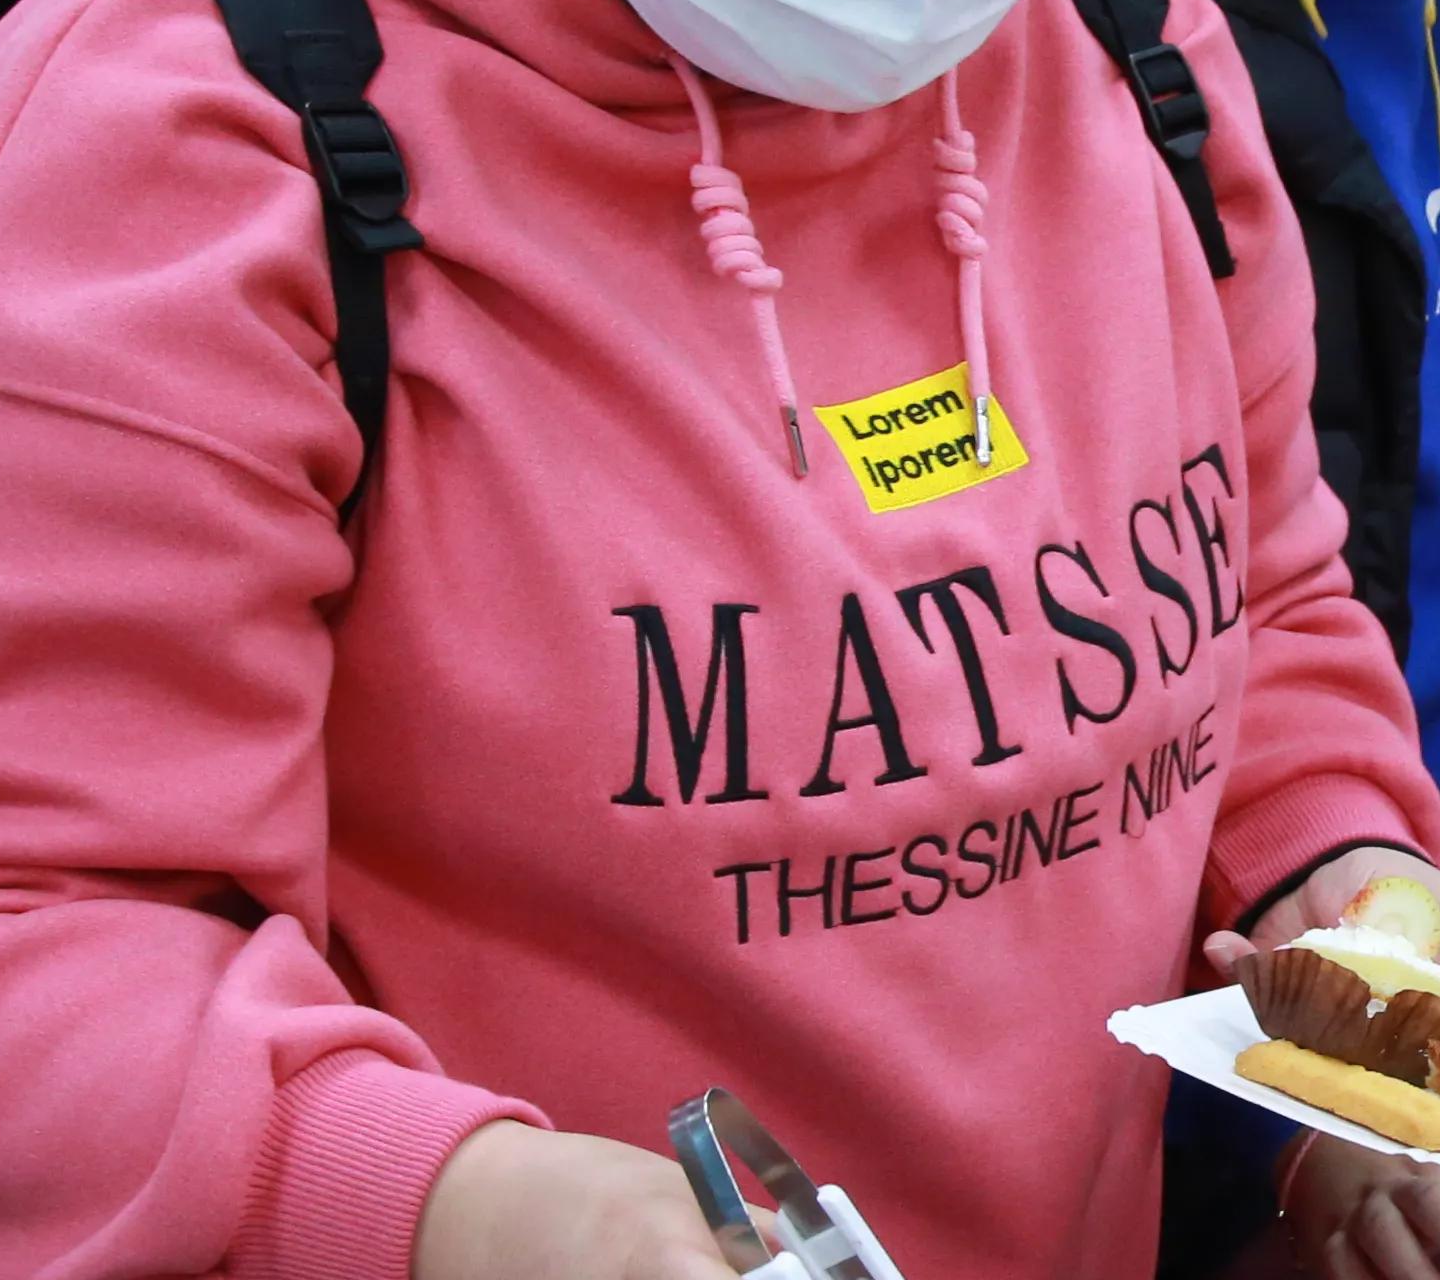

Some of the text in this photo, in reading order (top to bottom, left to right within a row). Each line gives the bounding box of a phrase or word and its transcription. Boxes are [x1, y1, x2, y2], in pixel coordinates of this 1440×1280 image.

[841, 389, 965, 441] Lorem
[610, 443, 1244, 808] MATSSE
[713, 702, 1217, 945] THESSINE NINE
